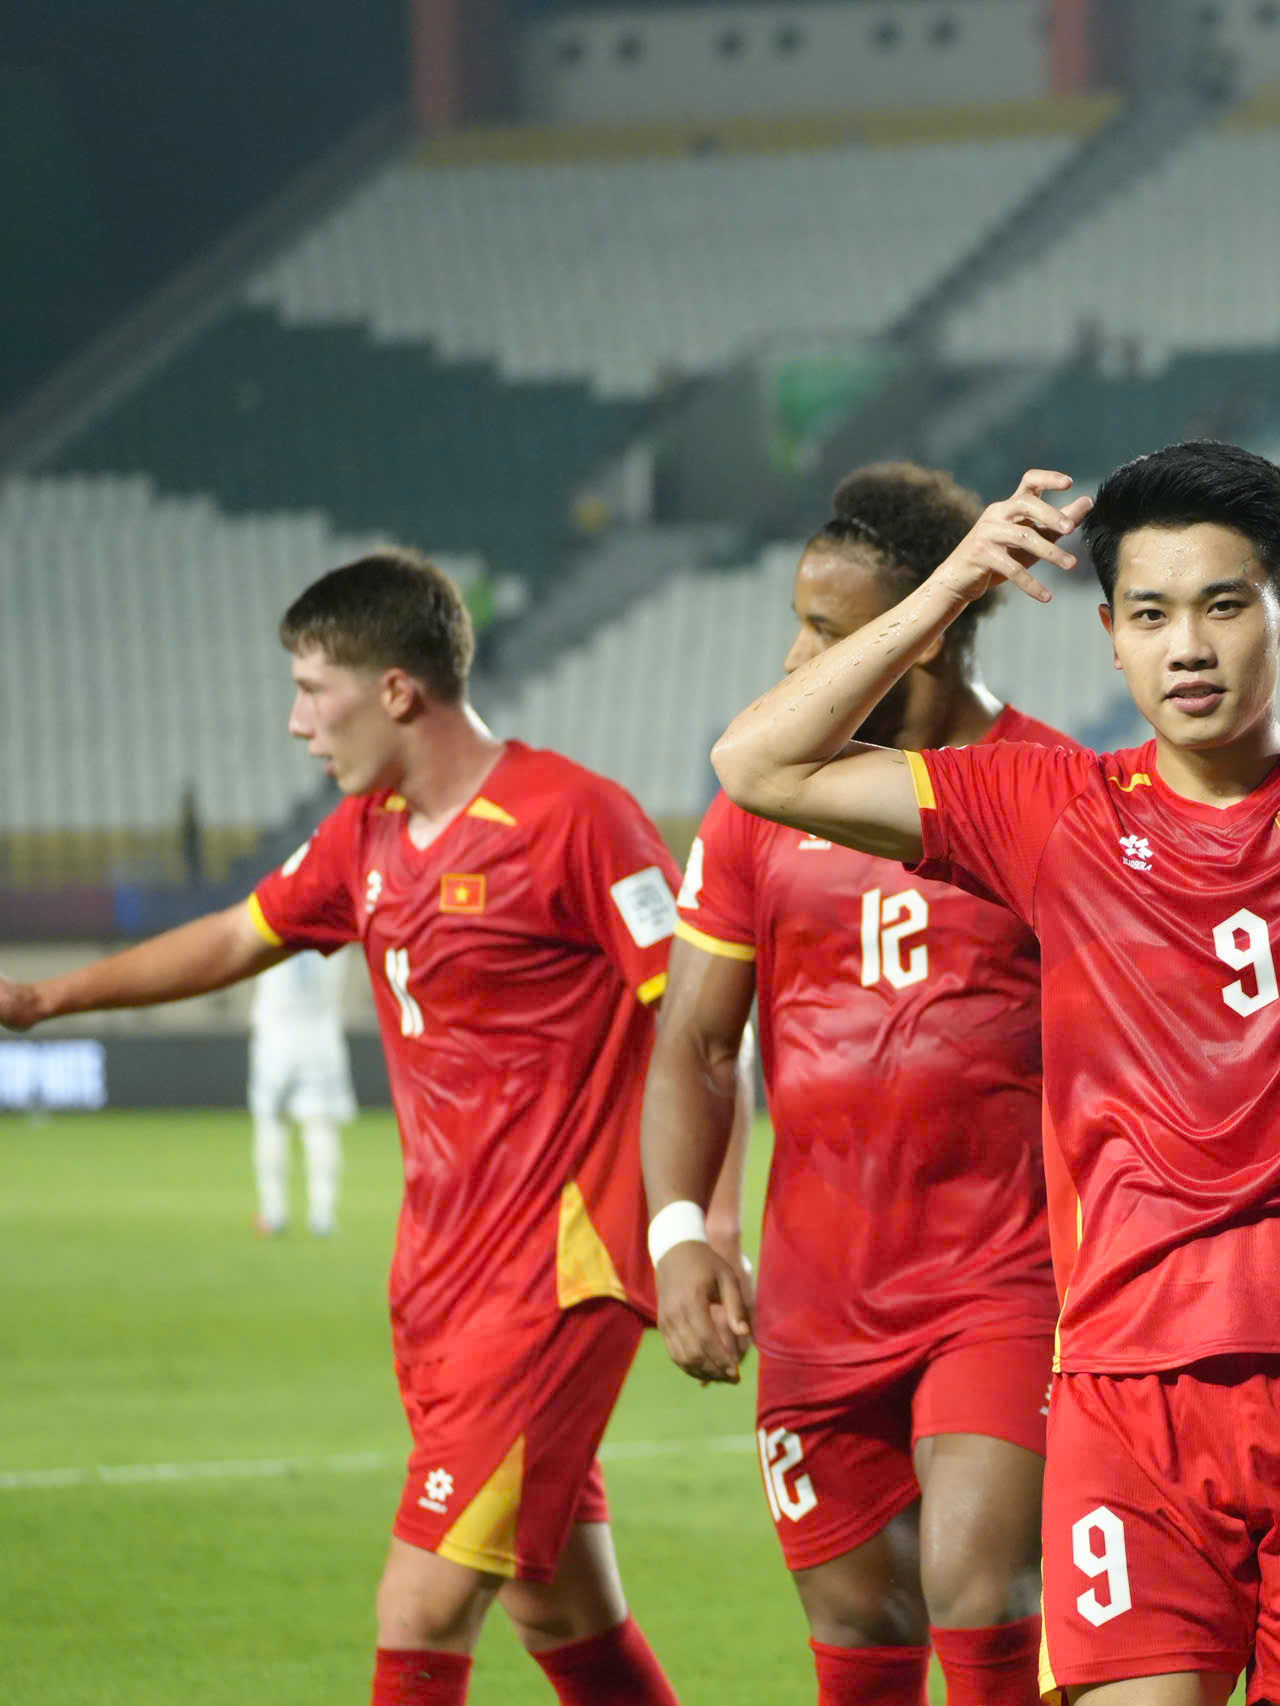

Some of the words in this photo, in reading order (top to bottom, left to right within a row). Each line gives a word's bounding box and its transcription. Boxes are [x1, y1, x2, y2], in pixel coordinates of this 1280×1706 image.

[861, 888, 929, 990] 12
[1212, 907, 1280, 1018] 9
[384, 947, 425, 1038] 11
[757, 1426, 819, 1523] 12
[1071, 1505, 1133, 1628] 9
